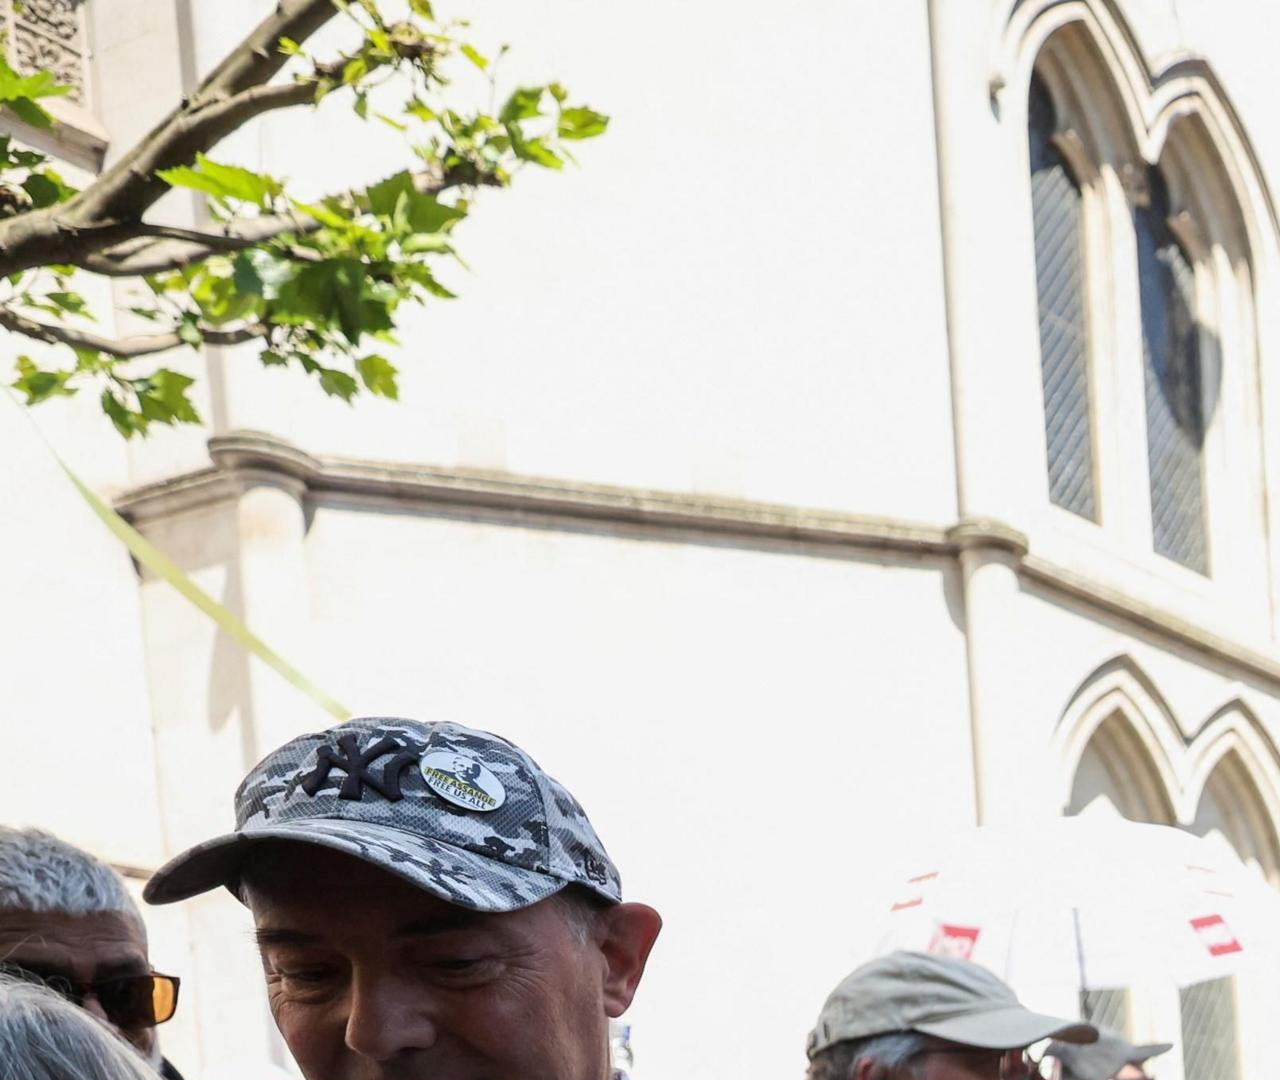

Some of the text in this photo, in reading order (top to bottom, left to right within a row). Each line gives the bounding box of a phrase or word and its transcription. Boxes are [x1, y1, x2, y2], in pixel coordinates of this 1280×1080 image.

[427, 768, 450, 783] FREE
[450, 779, 494, 806] ASSANGE
[428, 777, 450, 792] FREE
[454, 789, 467, 800] US
[468, 797, 486, 809] ALL
